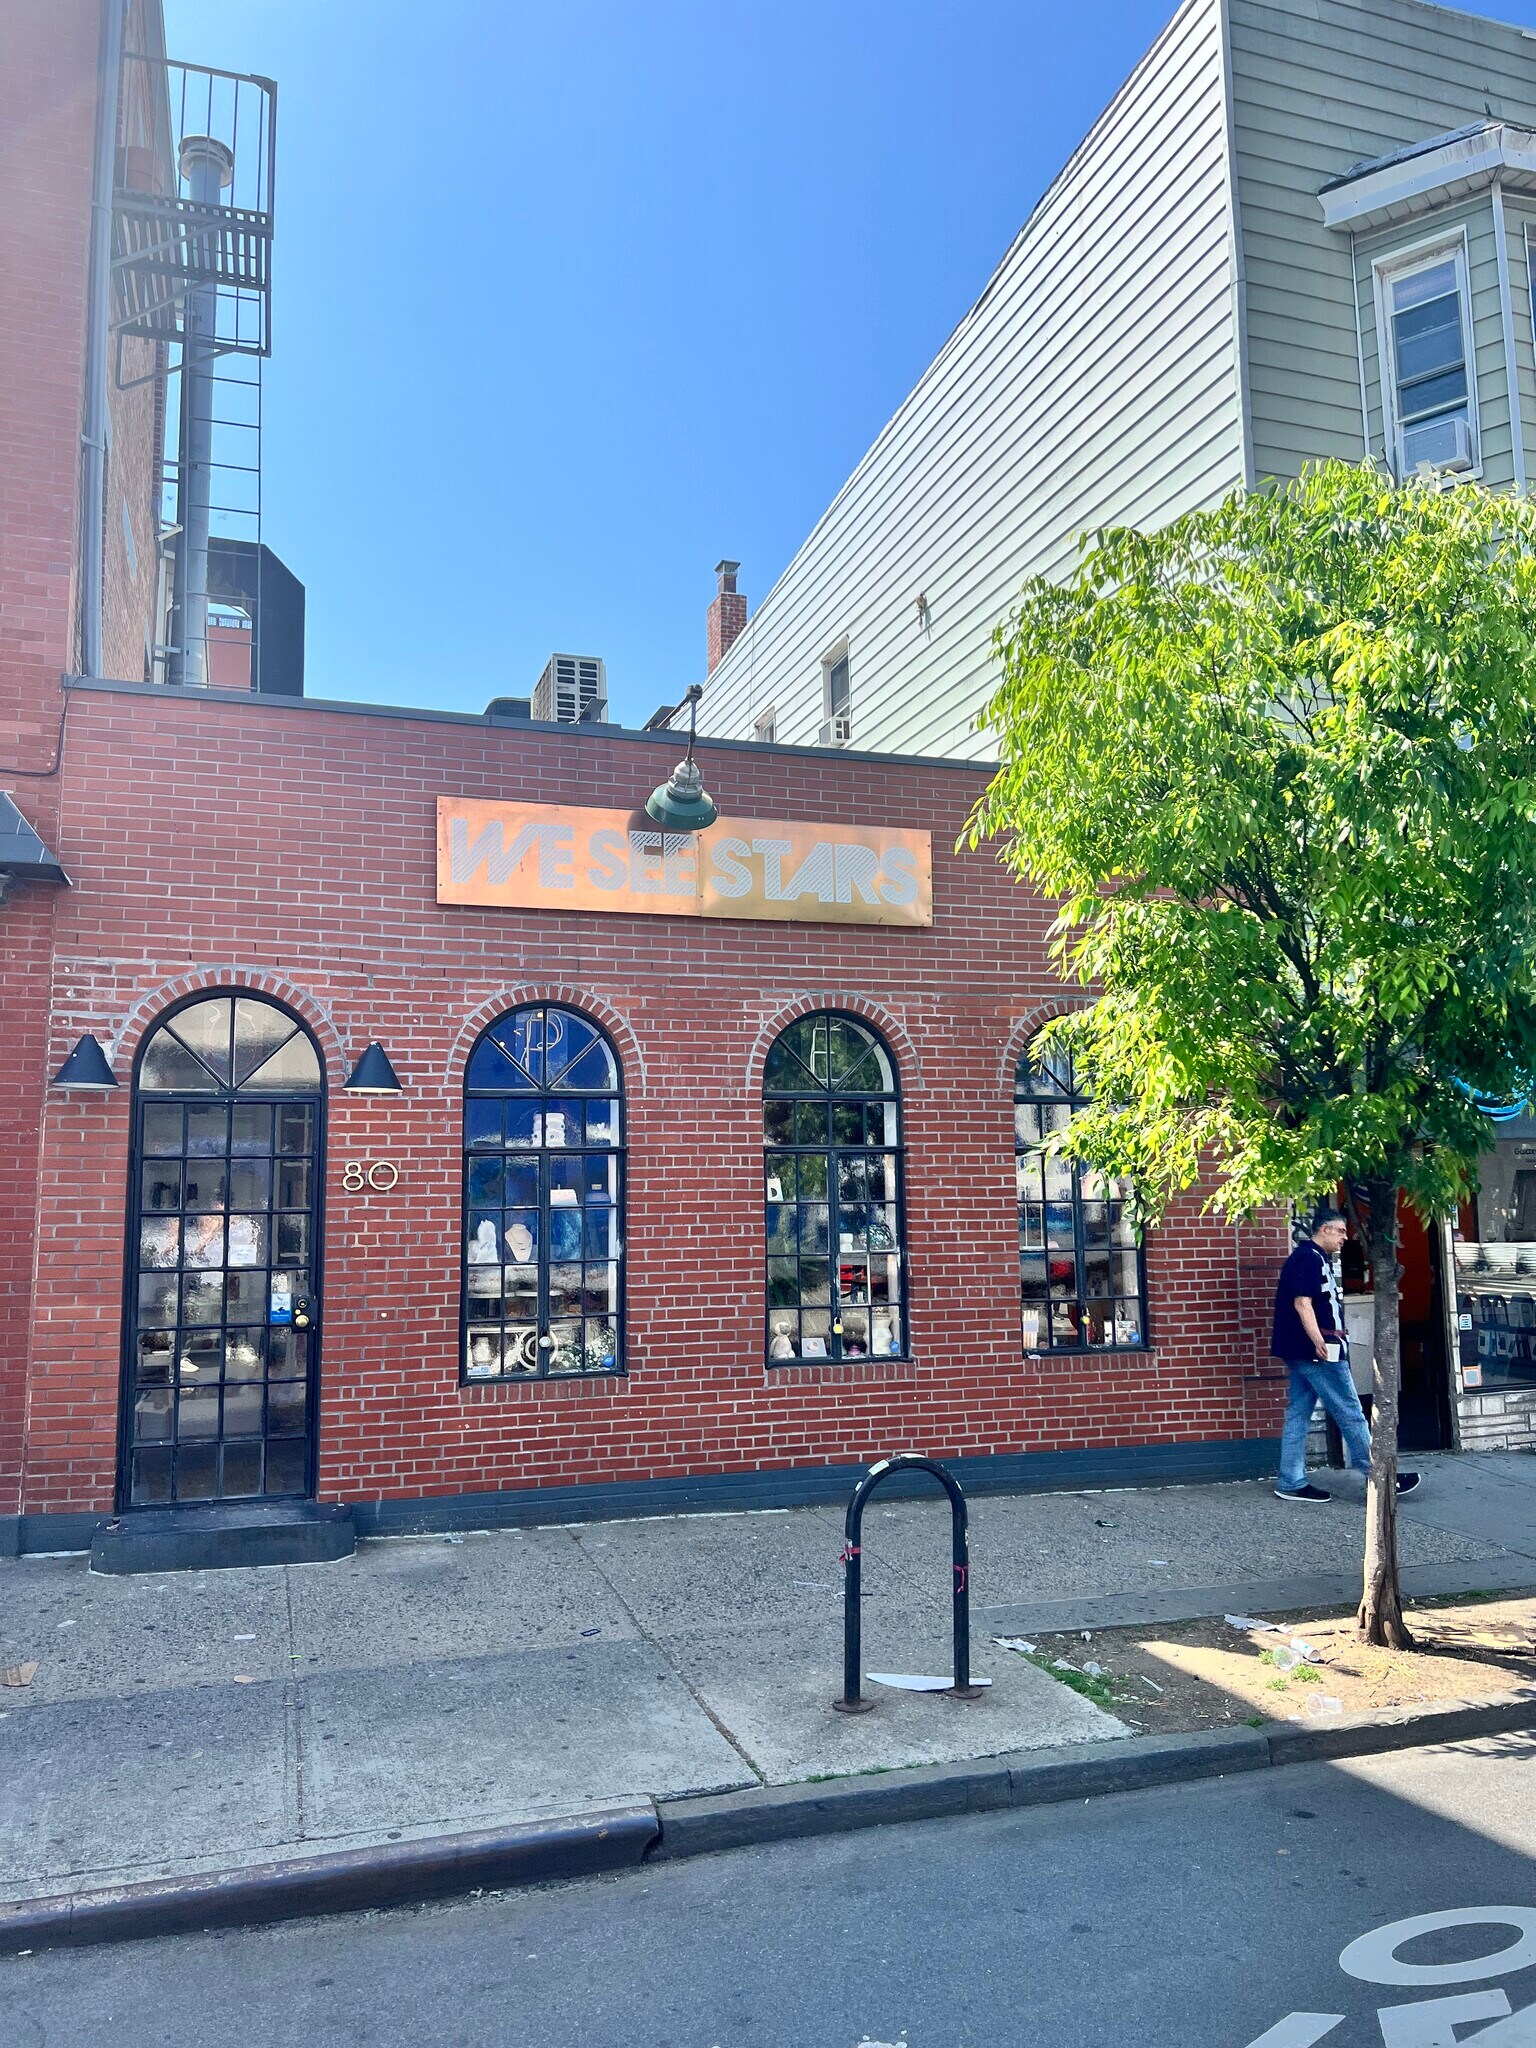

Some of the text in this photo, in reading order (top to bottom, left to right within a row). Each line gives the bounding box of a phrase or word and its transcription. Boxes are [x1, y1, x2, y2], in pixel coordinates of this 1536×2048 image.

[451, 818, 919, 906] WE SEE STARS
[342, 1161, 399, 1191] 80
